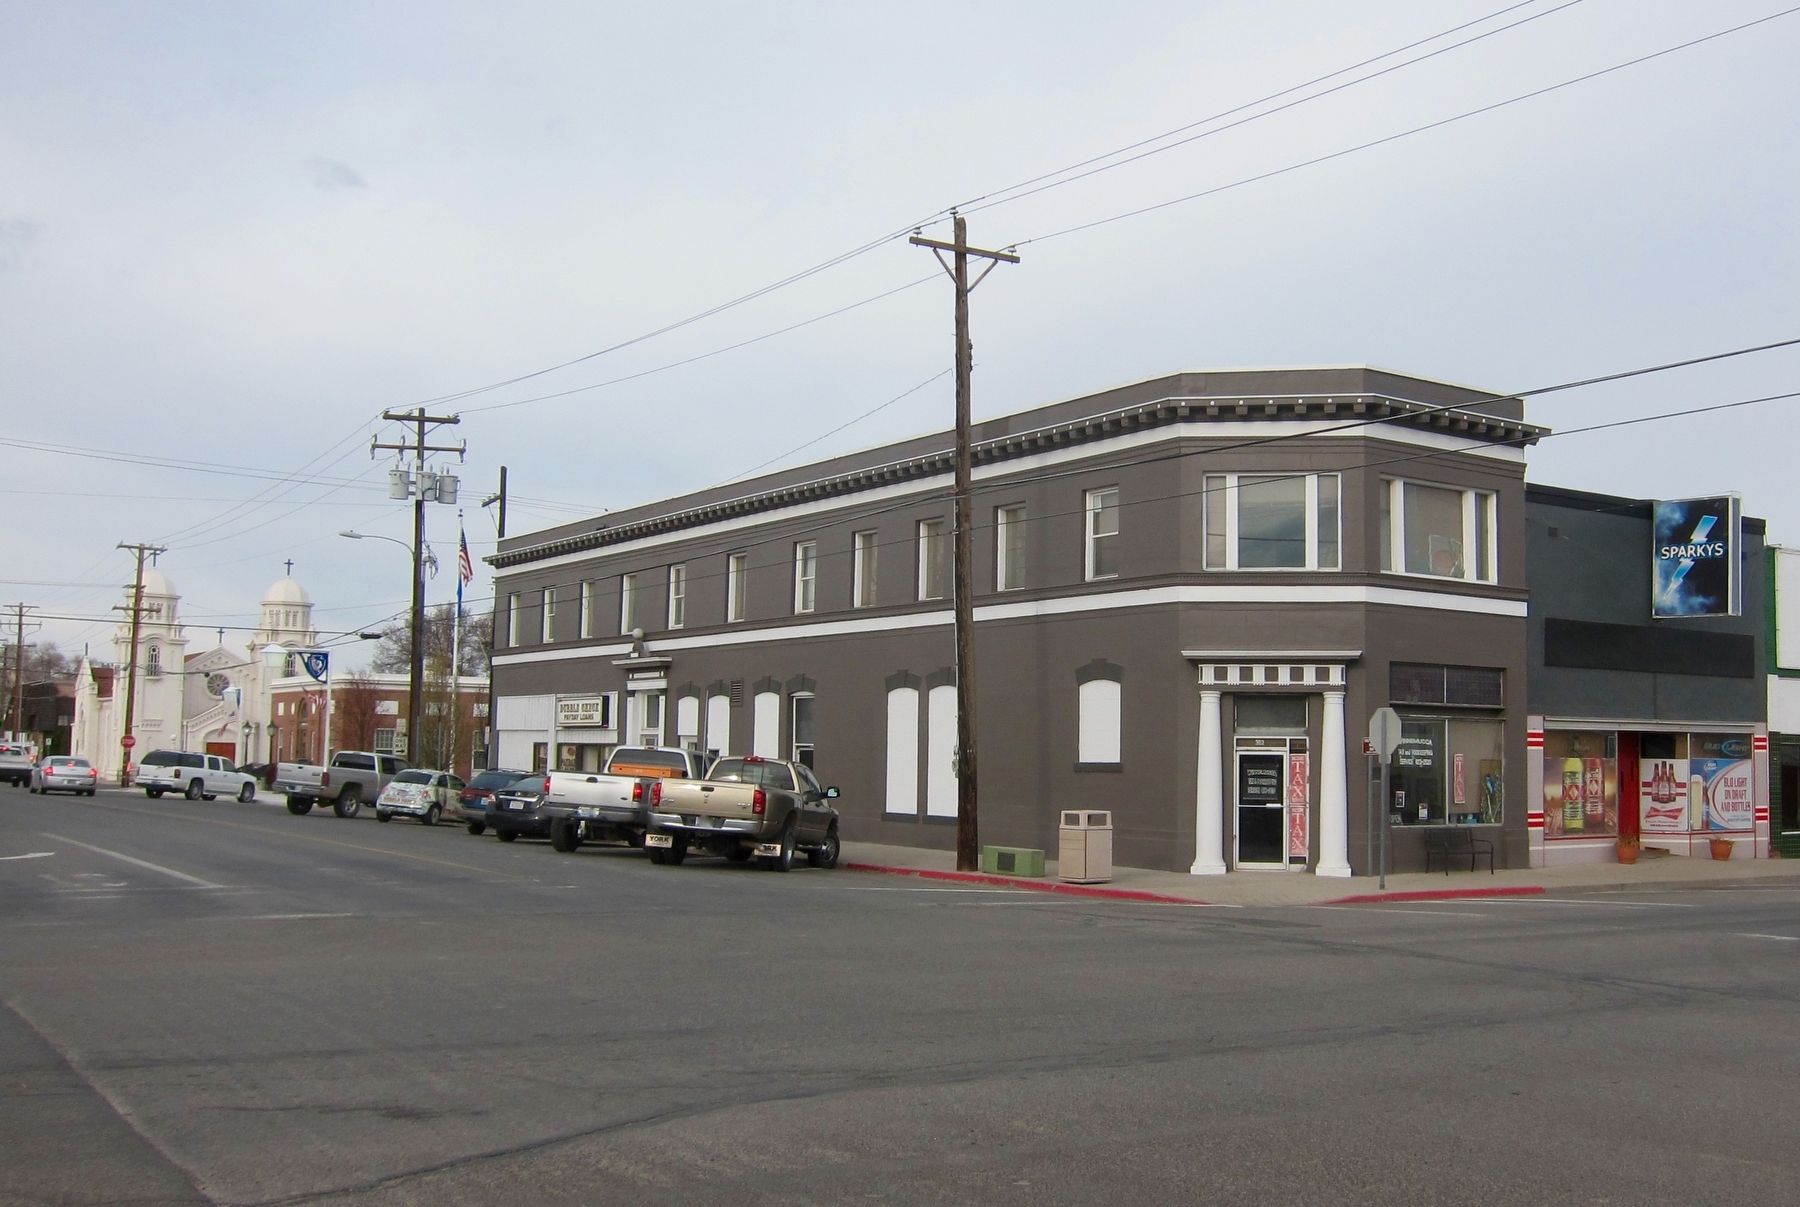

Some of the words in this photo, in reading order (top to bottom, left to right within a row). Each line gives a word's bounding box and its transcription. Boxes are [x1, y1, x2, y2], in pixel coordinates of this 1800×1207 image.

[1661, 543, 1724, 559] SPARKYS
[1292, 761, 1305, 797] TAX
[1735, 777, 1748, 787] LIGHT
[1725, 790, 1732, 799] ON
[1732, 790, 1746, 799] DRAFT
[1721, 802, 1731, 812] AND
[1731, 802, 1751, 812] BOTTLES
[1292, 812, 1305, 849] TAX
